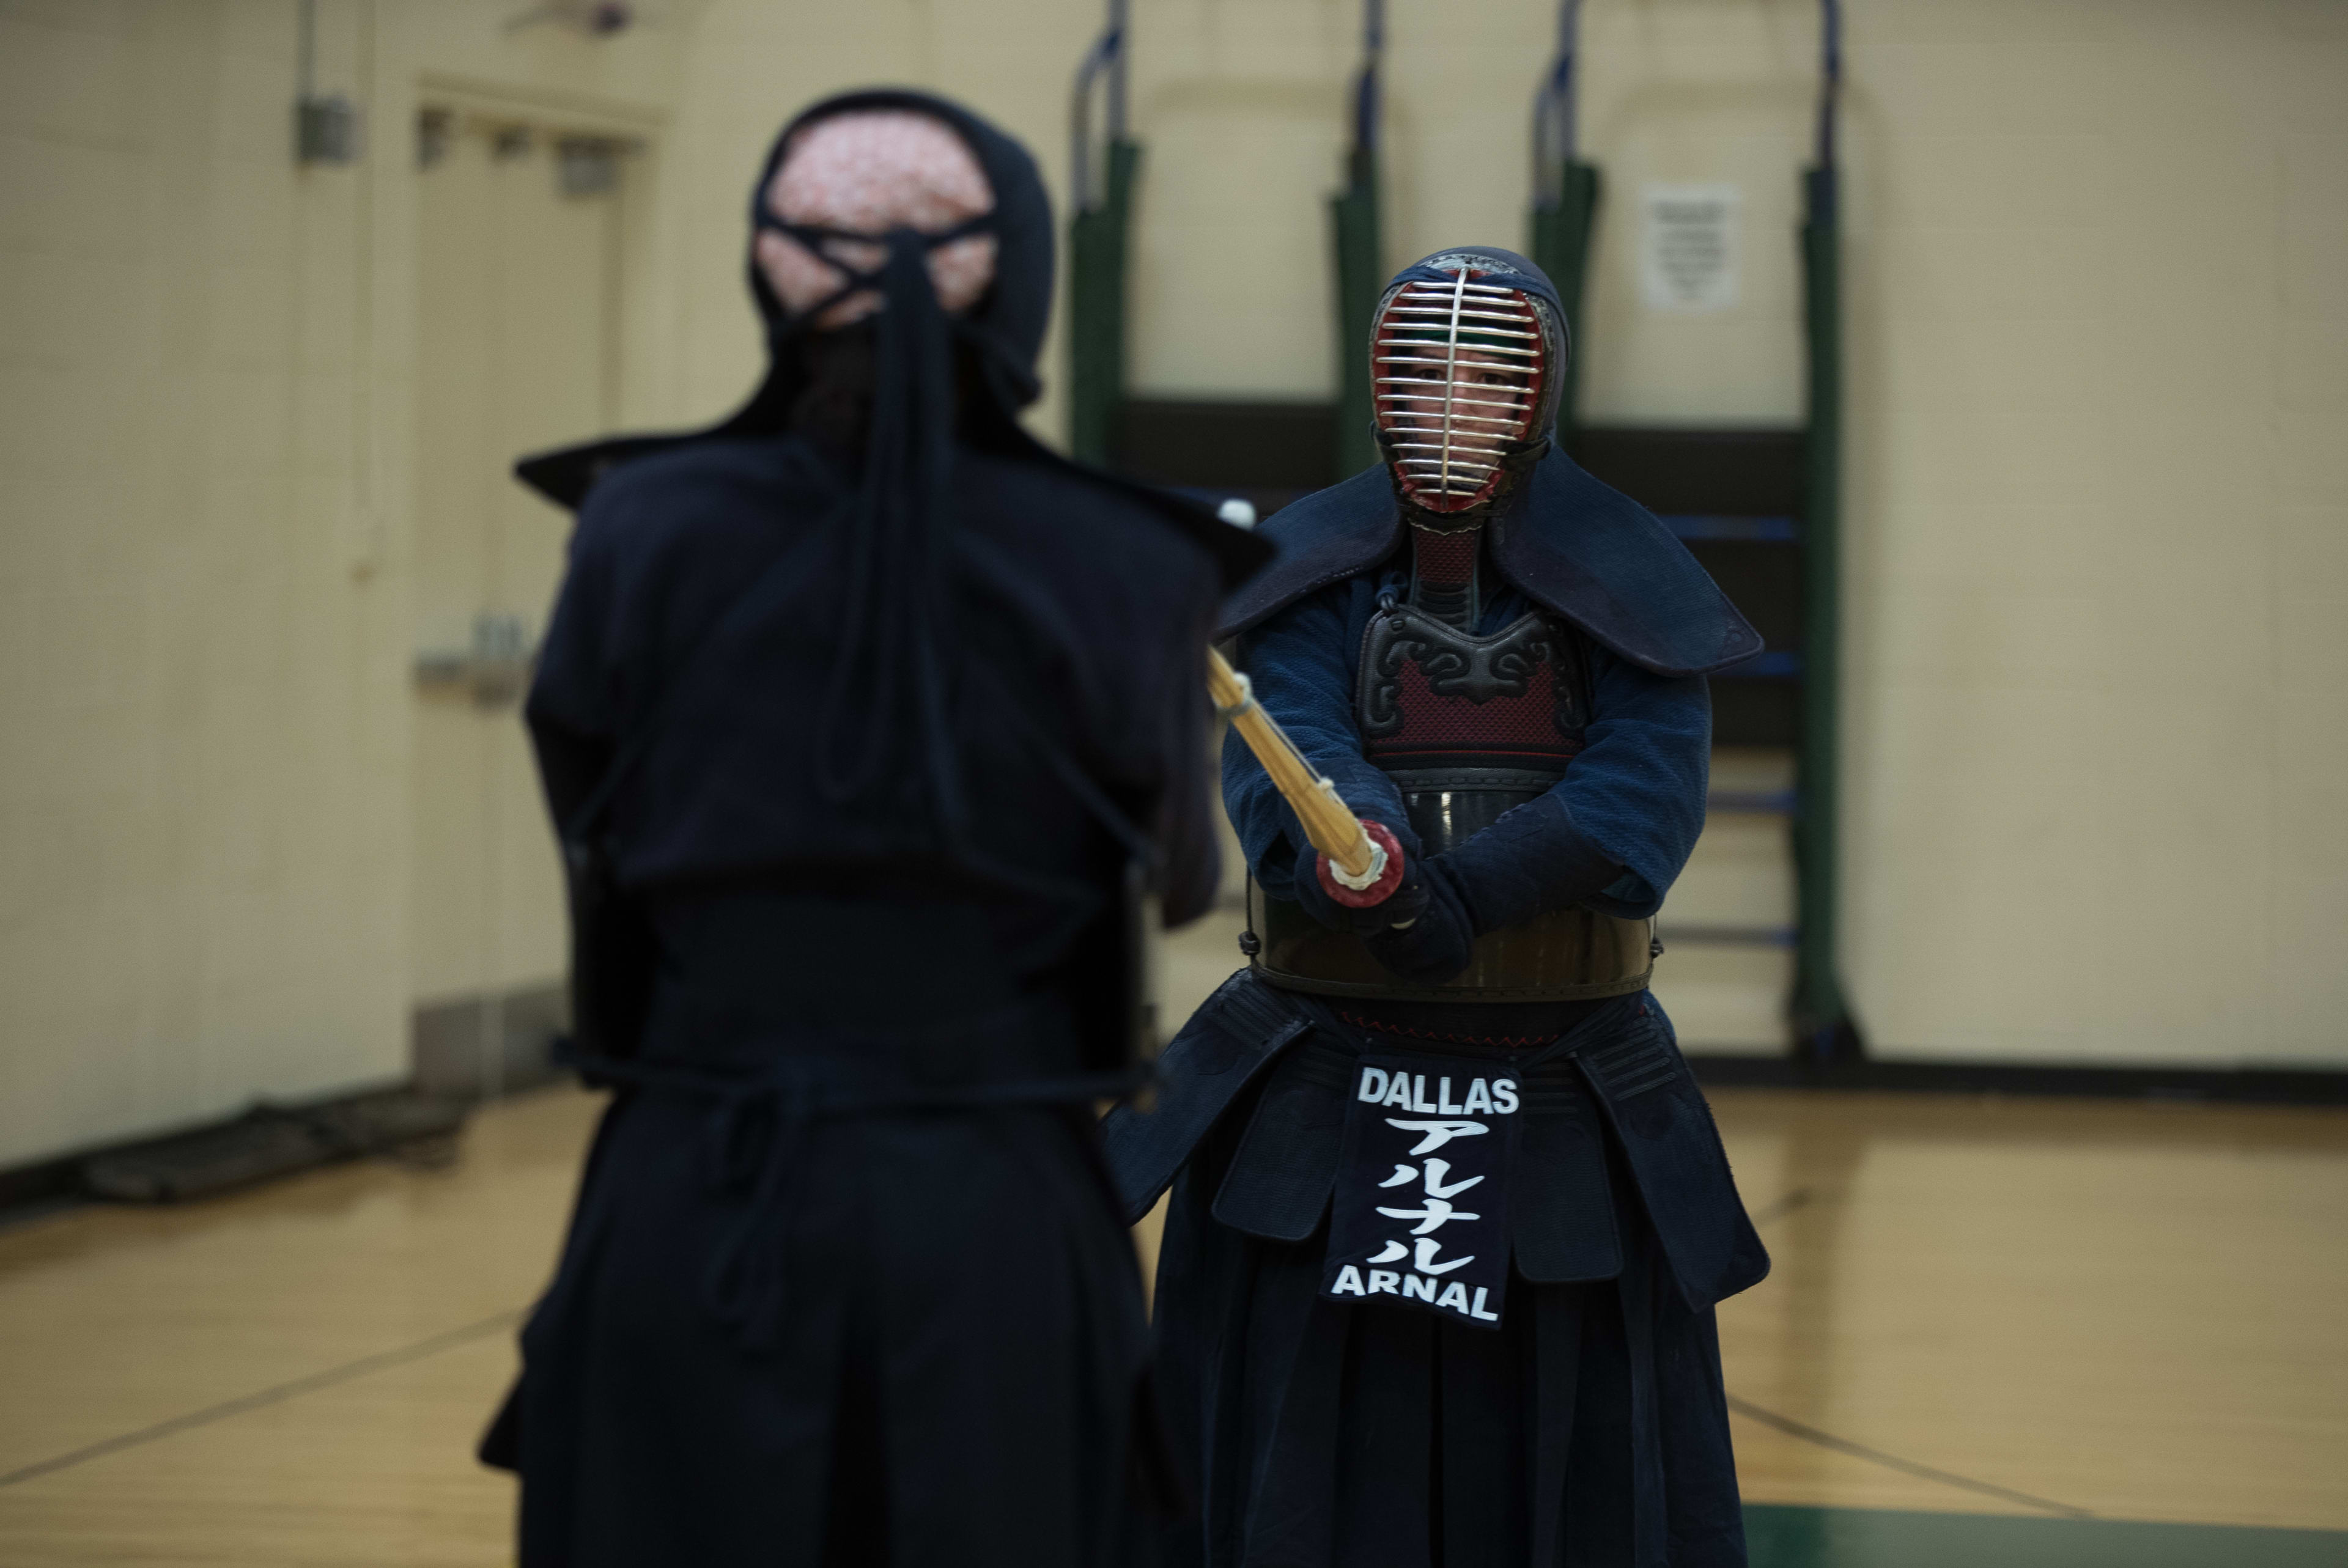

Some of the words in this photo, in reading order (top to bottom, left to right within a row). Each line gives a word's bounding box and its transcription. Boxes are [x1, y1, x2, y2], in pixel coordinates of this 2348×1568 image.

[1357, 1067, 1520, 1115] DALLAS
[1365, 1117, 1490, 1276] アルナル
[1330, 1264, 1499, 1322] ARNAL
